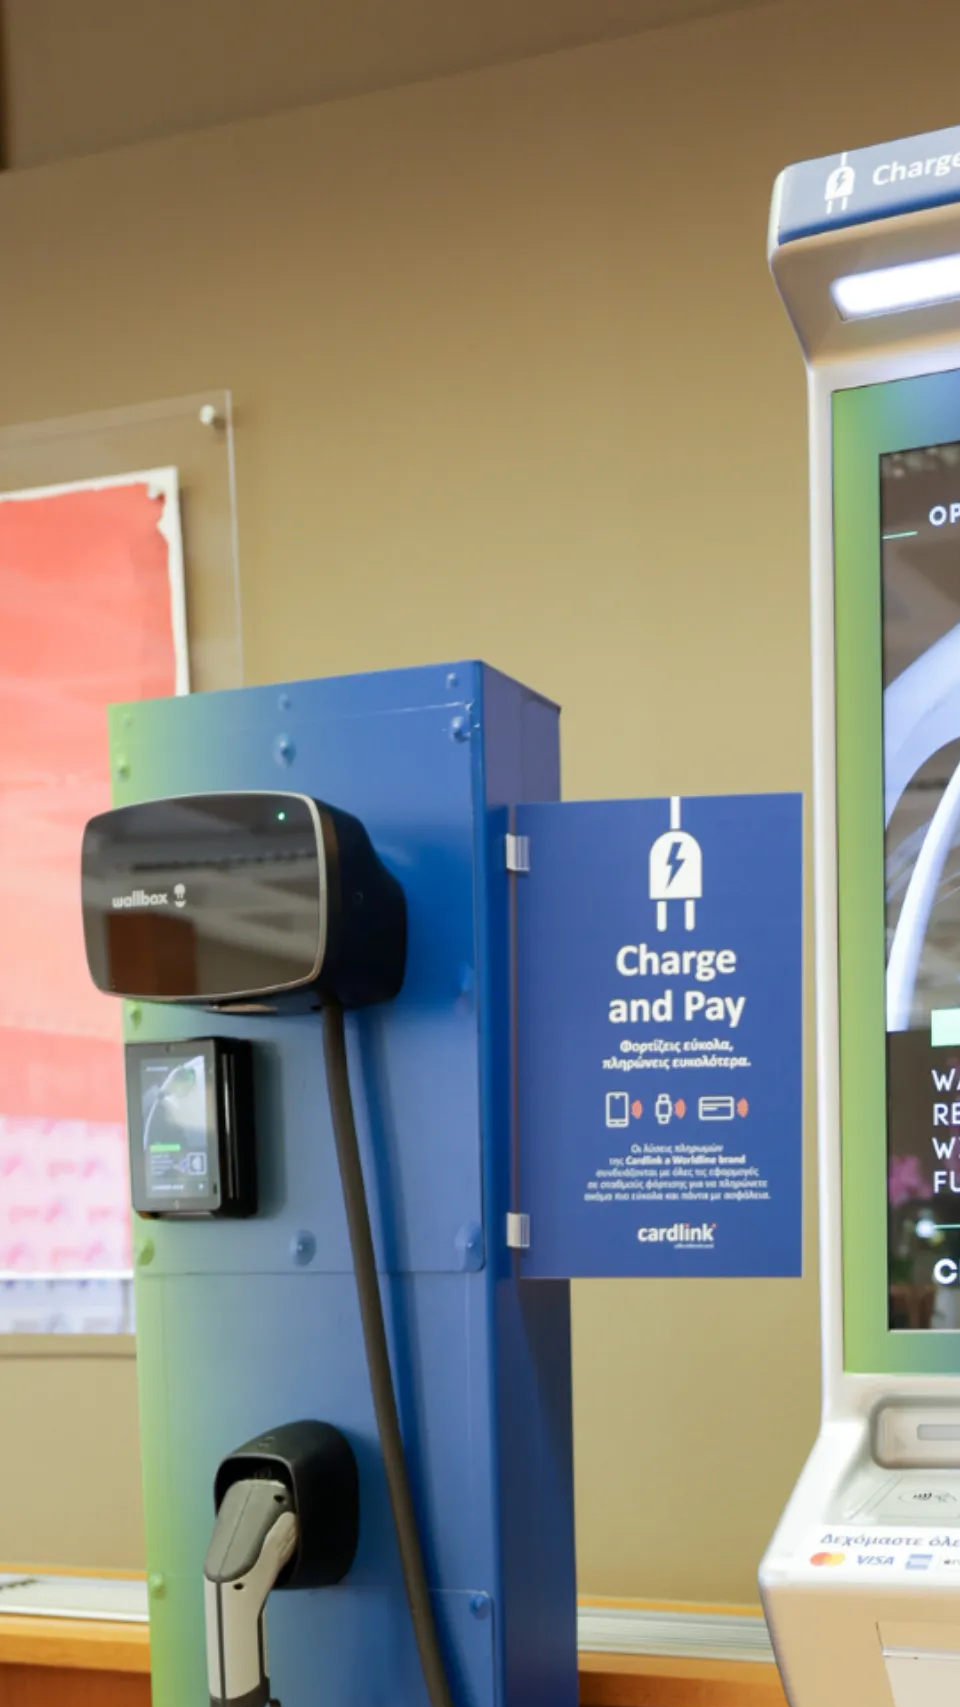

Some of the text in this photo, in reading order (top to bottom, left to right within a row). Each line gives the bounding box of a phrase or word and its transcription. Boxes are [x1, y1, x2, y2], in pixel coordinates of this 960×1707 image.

[111, 889, 169, 909] wallbox
[616, 942, 737, 981] Charge
[609, 990, 745, 1028] and Pay
[637, 1223, 714, 1242] cardlink
[820, 1533, 923, 1548] Δεχόμαστε
[857, 1554, 895, 1566] VISA
